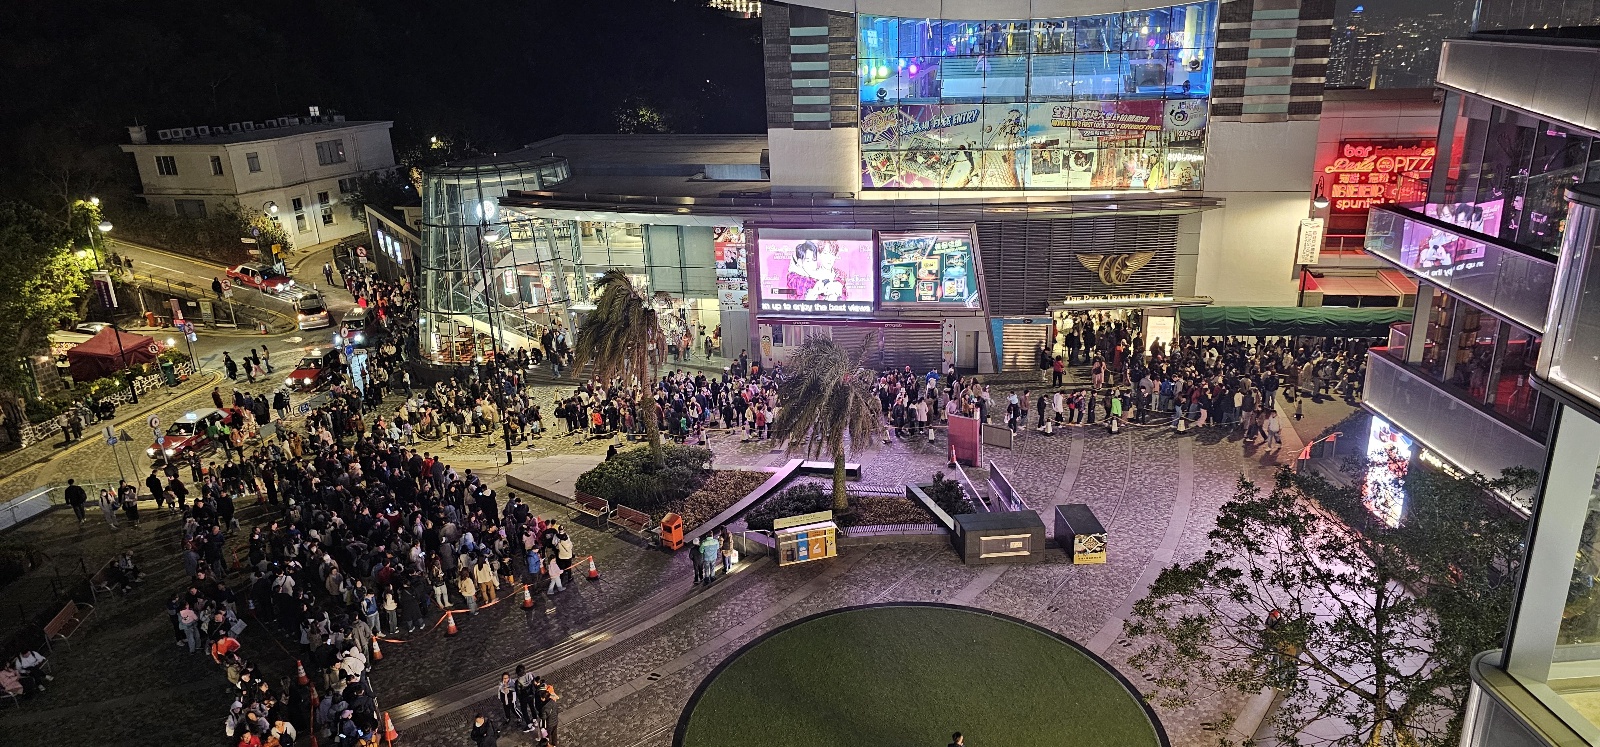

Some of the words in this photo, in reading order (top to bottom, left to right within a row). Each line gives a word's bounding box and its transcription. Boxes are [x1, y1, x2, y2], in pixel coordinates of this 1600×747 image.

[933, 114, 953, 129] FREE
[953, 109, 980, 126] ENTRY
[1344, 144, 1373, 157] bar
[1375, 145, 1421, 156] Eccellente
[1325, 155, 1377, 173] Pasta
[1394, 156, 1432, 173] PIZZ
[1083, 294, 1105, 302] PEAK
[772, 303, 782, 311] up
[783, 302, 792, 310] to
[793, 303, 813, 312] enjoy
[814, 303, 827, 311] the
[828, 303, 846, 312] best
[847, 304, 870, 312] views
